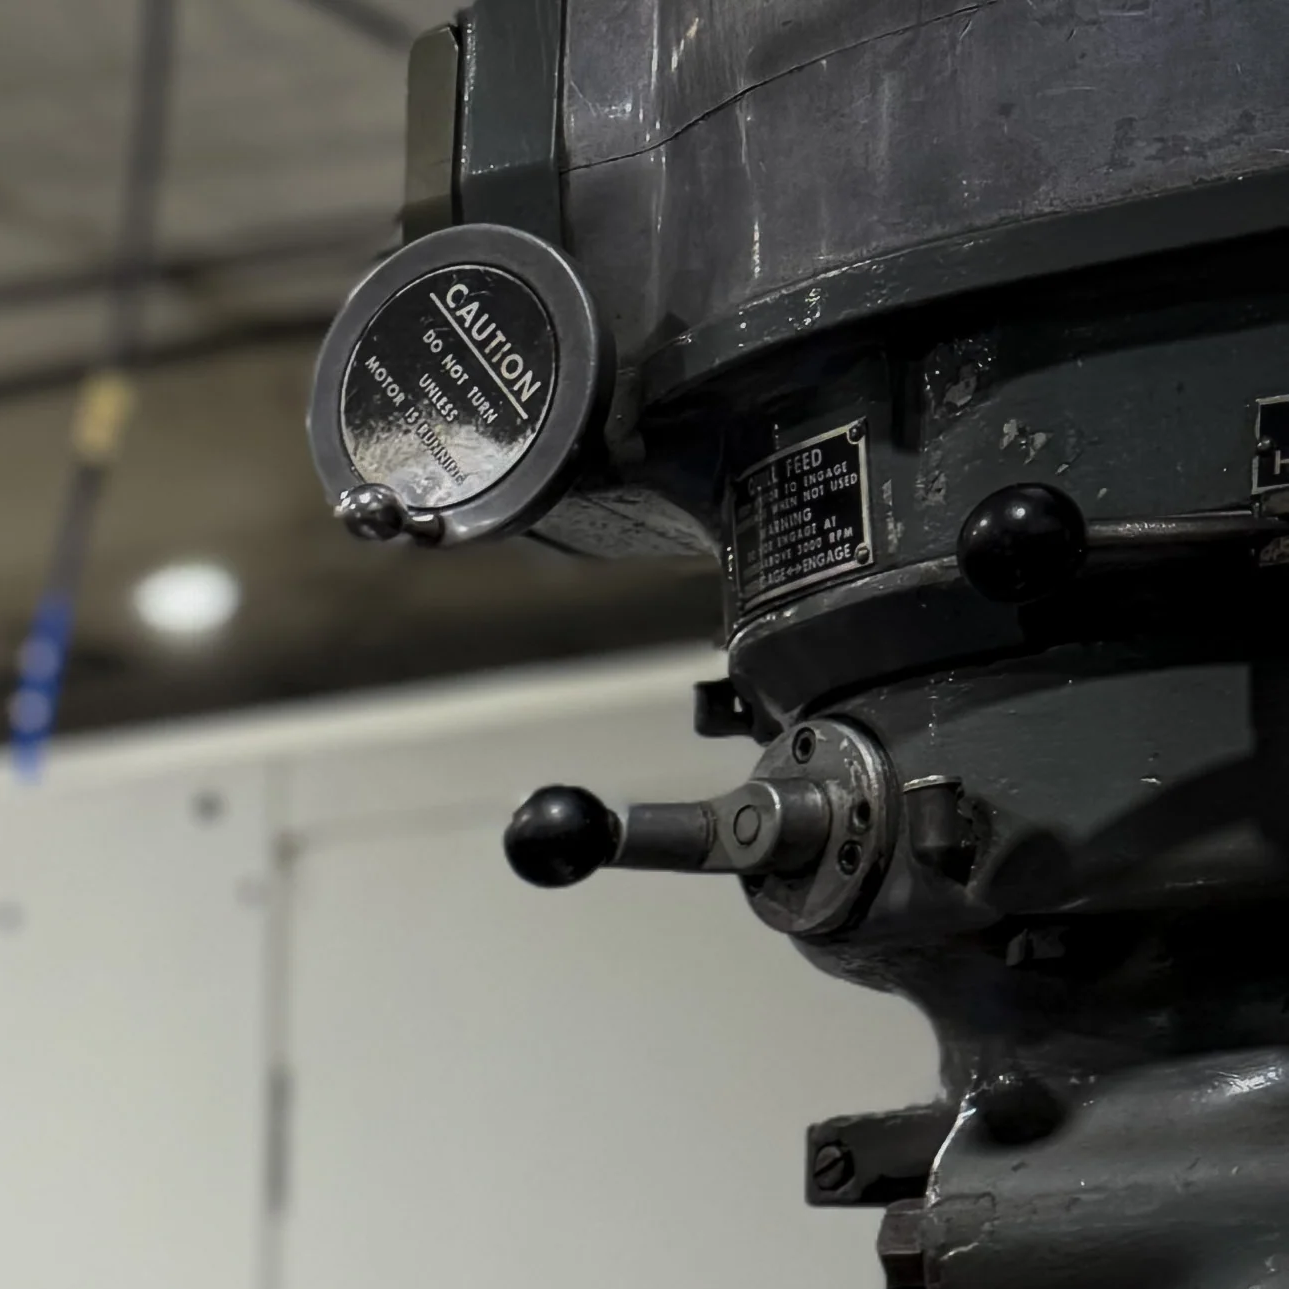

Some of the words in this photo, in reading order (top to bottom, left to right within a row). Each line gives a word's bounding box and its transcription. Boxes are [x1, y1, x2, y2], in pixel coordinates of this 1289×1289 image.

[445, 283, 542, 402] CAUTION
[365, 356, 405, 407] MOTOR
[405, 407, 419, 425] IS
[423, 329, 443, 353] DO
[441, 353, 469, 386] NOT
[467, 386, 498, 424] TURN
[418, 373, 458, 423] UNLESS
[785, 448, 823, 478] FEED
[803, 461, 848, 487] ENGAGE
[803, 486, 825, 504] NOT
[830, 472, 858, 492] USED
[823, 515, 837, 530] AT
[828, 525, 854, 545] RPM
[803, 542, 852, 574] ENGAGE
